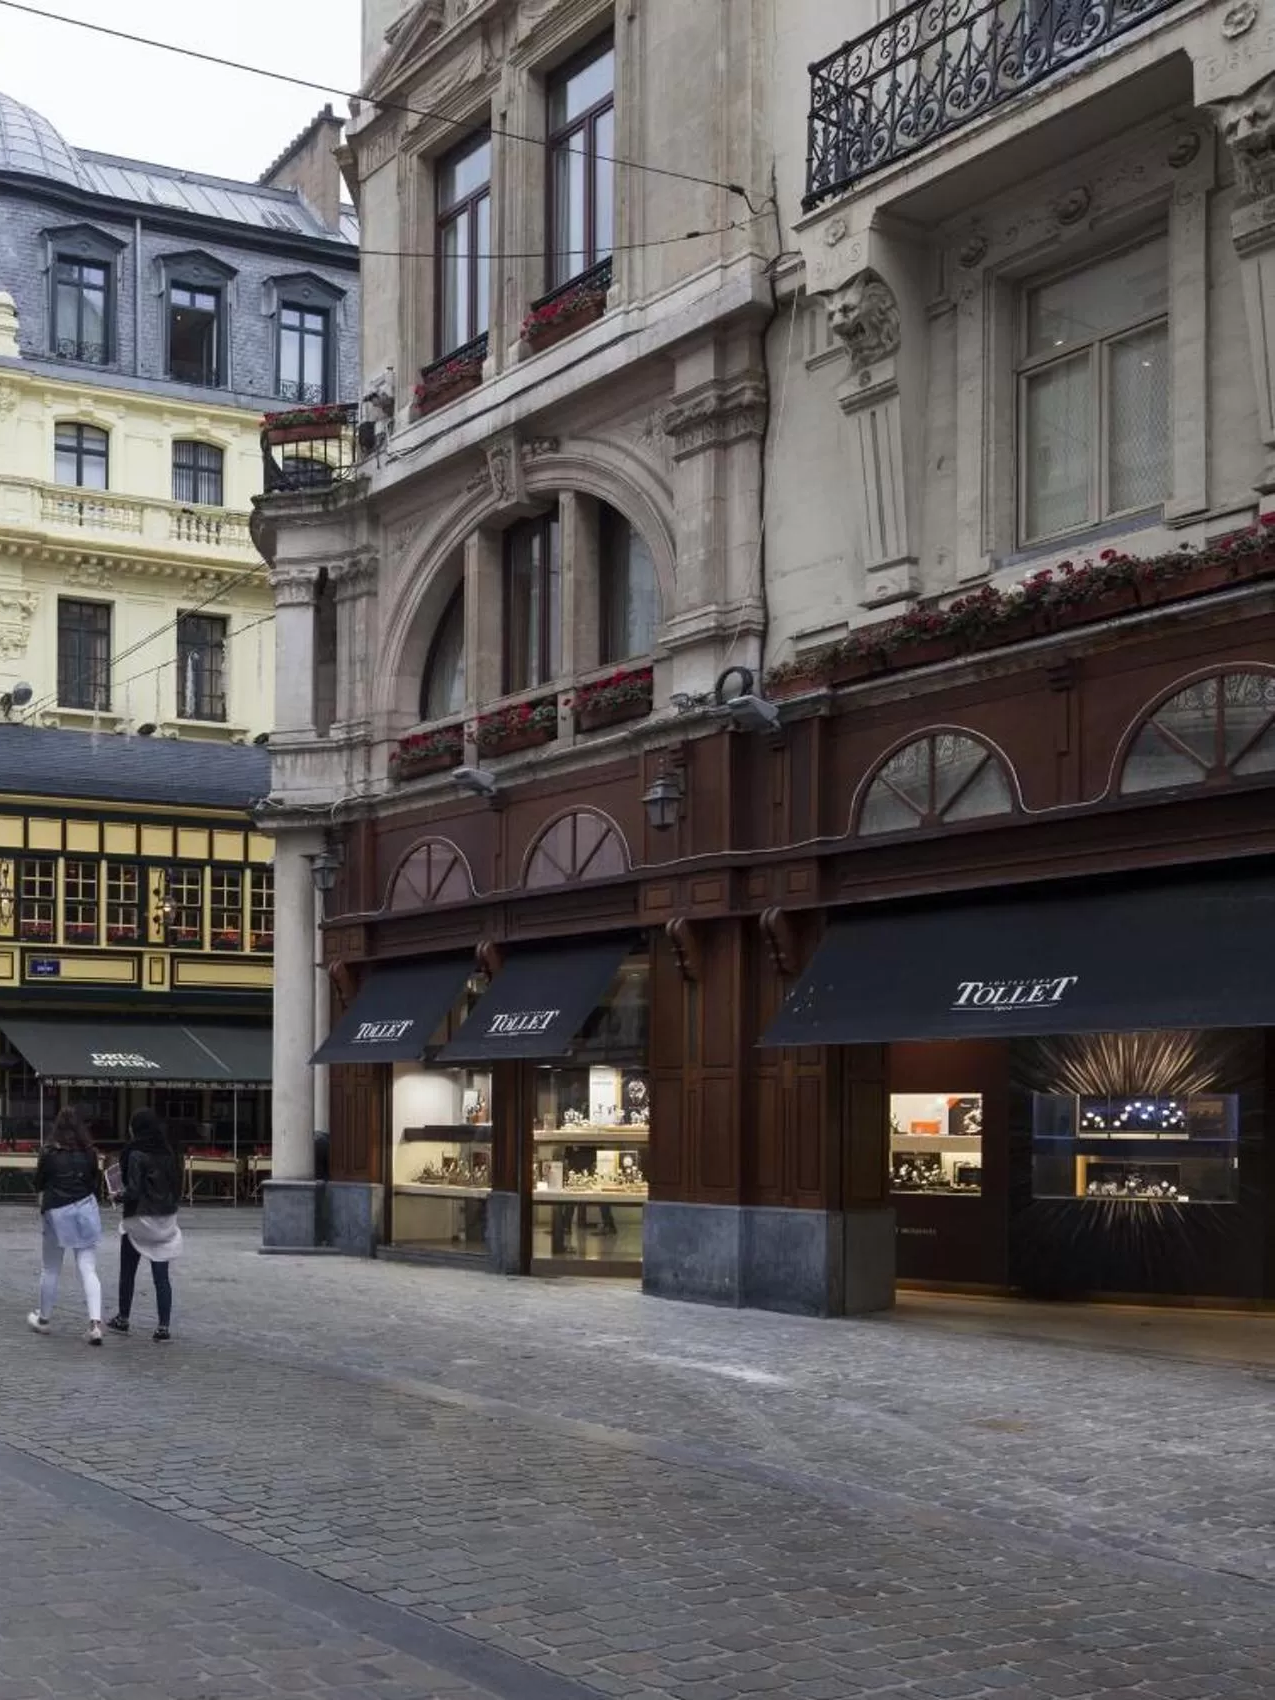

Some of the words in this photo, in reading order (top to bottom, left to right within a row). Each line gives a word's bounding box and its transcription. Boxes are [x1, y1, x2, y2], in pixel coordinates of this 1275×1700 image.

[952, 976, 1079, 1006] TOLLET
[354, 1019, 413, 1040] TOLLET
[488, 1010, 560, 1033] TOLLET
[90, 1053, 146, 1061] DRUG
